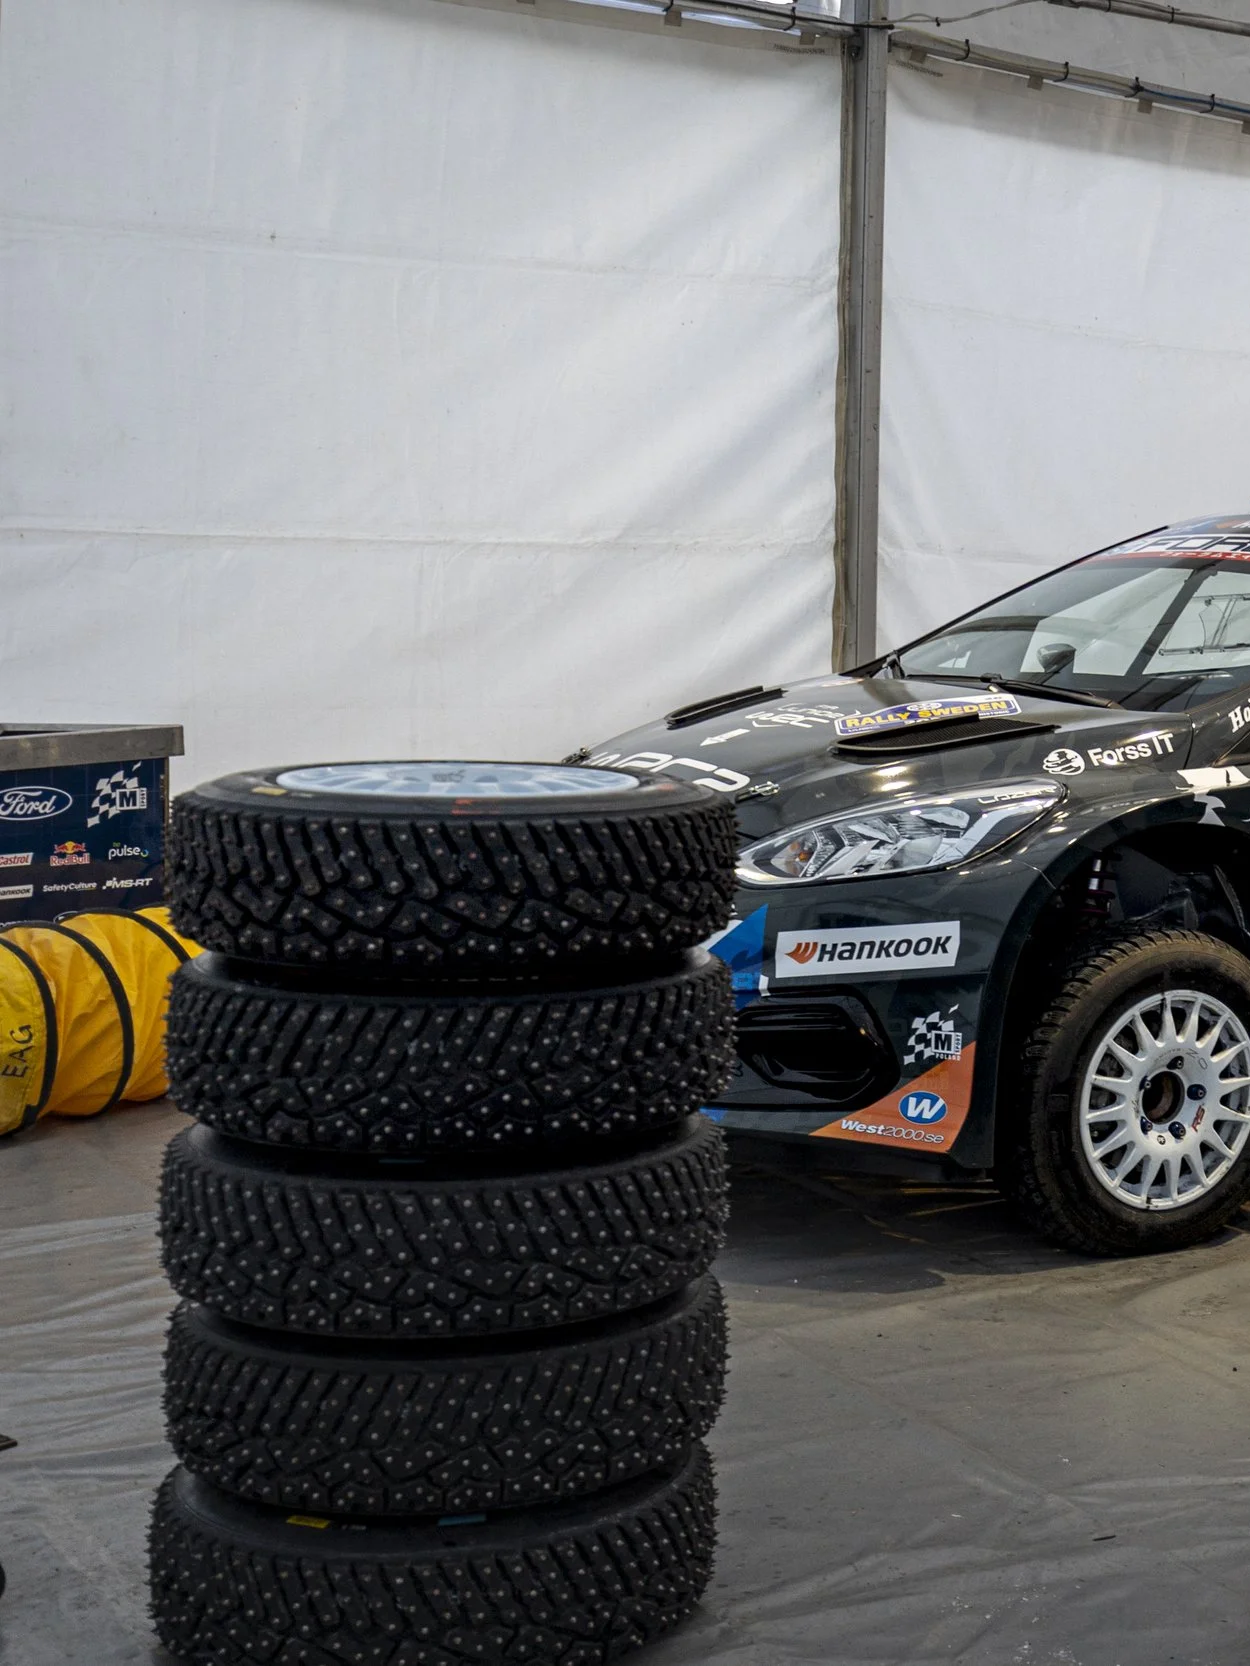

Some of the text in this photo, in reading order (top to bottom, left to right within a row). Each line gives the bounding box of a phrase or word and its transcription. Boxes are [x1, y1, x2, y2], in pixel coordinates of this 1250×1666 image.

[846, 710, 908, 728] RALLY
[917, 701, 1007, 718] SWEDEN
[1088, 733, 1175, 767] Forss IT
[0, 791, 57, 815] Ford
[108, 845, 141, 860] pulse
[43, 882, 97, 892] SafetyCulture
[934, 1033, 952, 1052] M
[935, 1053, 961, 1061] POLAND
[907, 1098, 945, 1119] W
[841, 1119, 944, 1143] West2000.se
